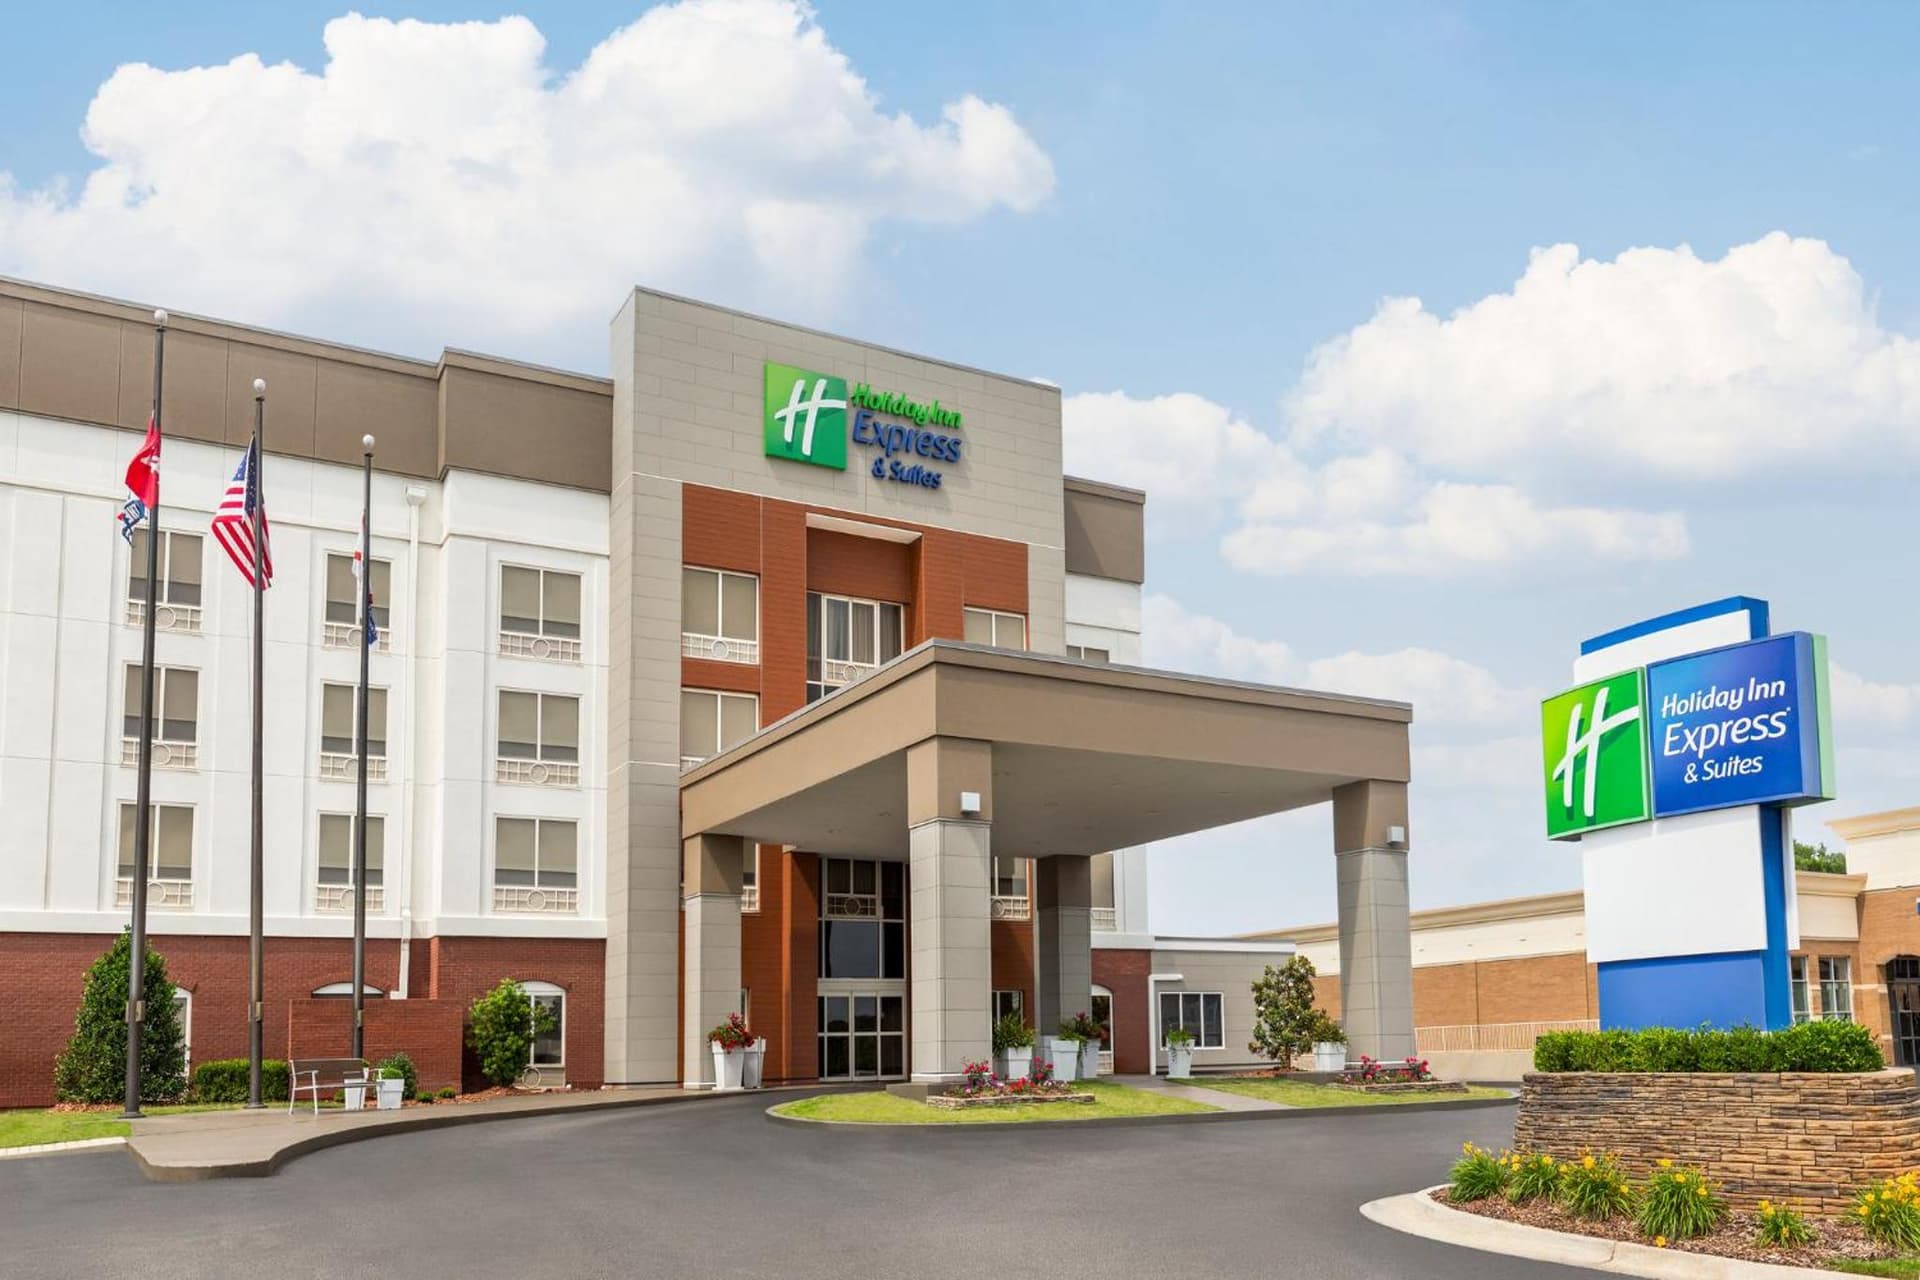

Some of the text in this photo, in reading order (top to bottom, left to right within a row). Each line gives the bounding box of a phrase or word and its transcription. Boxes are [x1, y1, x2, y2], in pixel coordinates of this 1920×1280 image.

[851, 383, 963, 429] Holiday Inn
[852, 409, 963, 463] Express
[871, 457, 943, 489] & Suites
[1661, 677, 1786, 719] Holiday Inn
[1663, 711, 1788, 759] Express
[1684, 755, 1764, 784] & Suites
